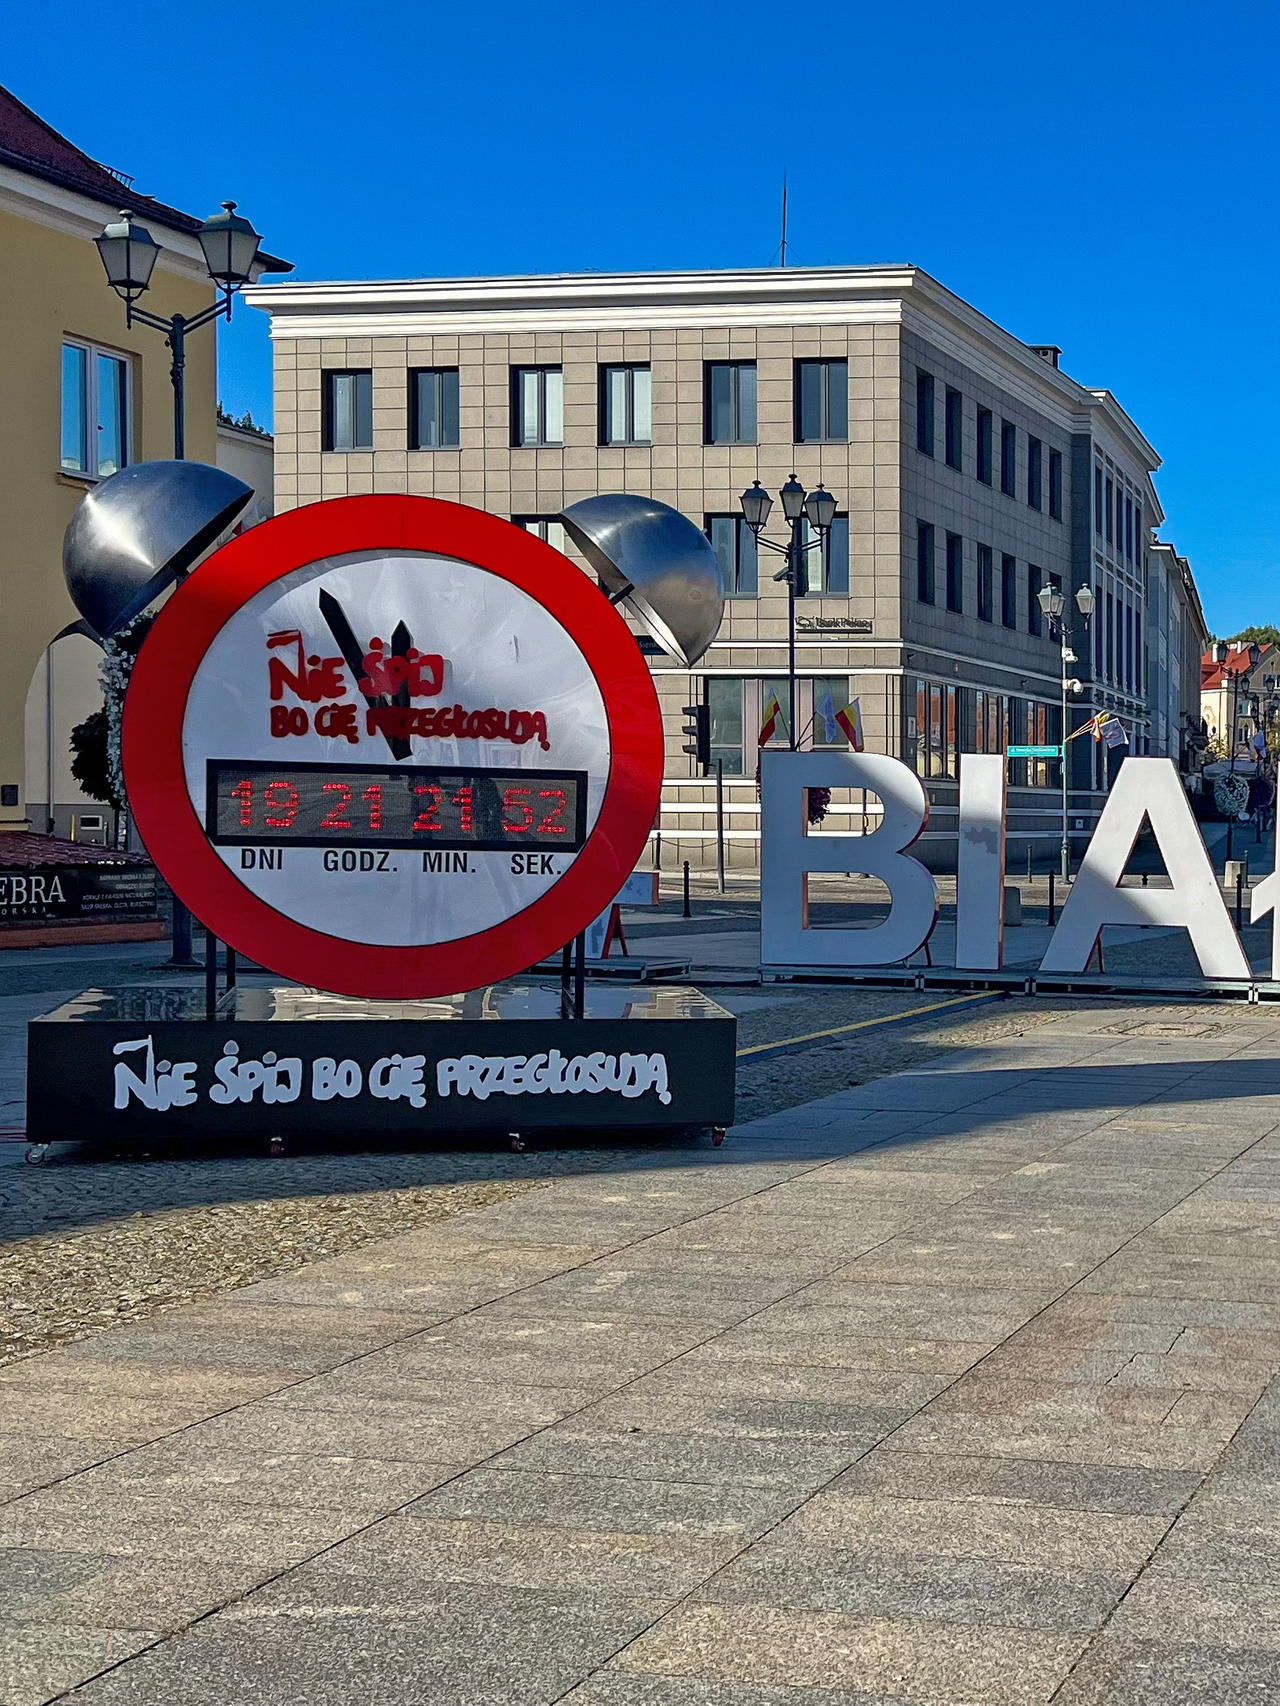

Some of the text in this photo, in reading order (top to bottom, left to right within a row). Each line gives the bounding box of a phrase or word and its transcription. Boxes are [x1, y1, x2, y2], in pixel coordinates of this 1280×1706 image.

[270, 705, 309, 738] BO
[240, 848, 562, 875] DNI GODZ. MIN. SEK.
[312, 1057, 363, 1100] BO
